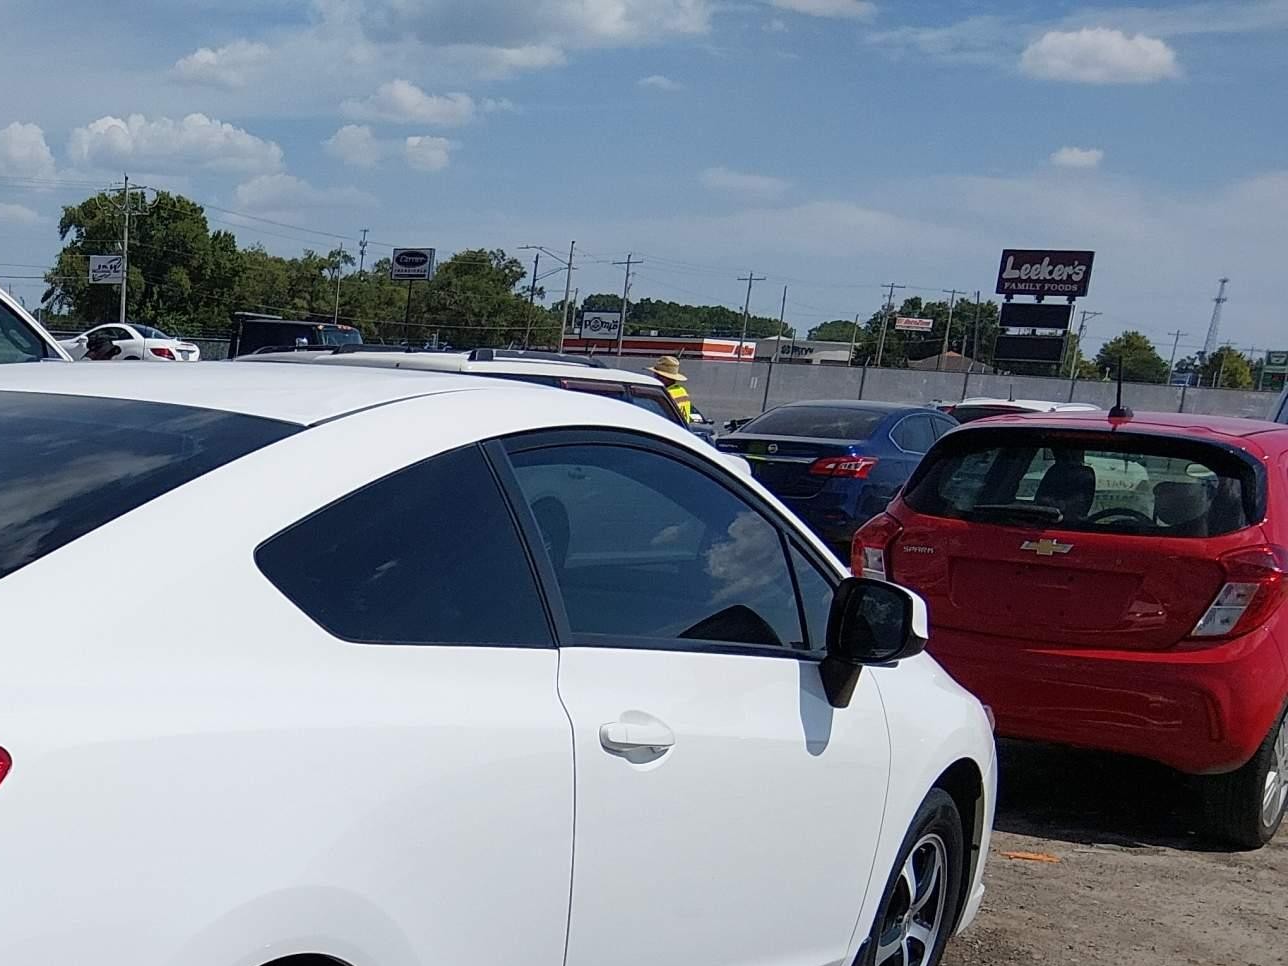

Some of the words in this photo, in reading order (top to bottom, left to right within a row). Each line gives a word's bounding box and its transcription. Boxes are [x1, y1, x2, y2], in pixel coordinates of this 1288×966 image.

[1002, 256, 1087, 281] Leeker's
[1004, 282, 1042, 290] FAMILY
[1044, 283, 1078, 292] FOODS
[903, 545, 934, 554] SPARK
